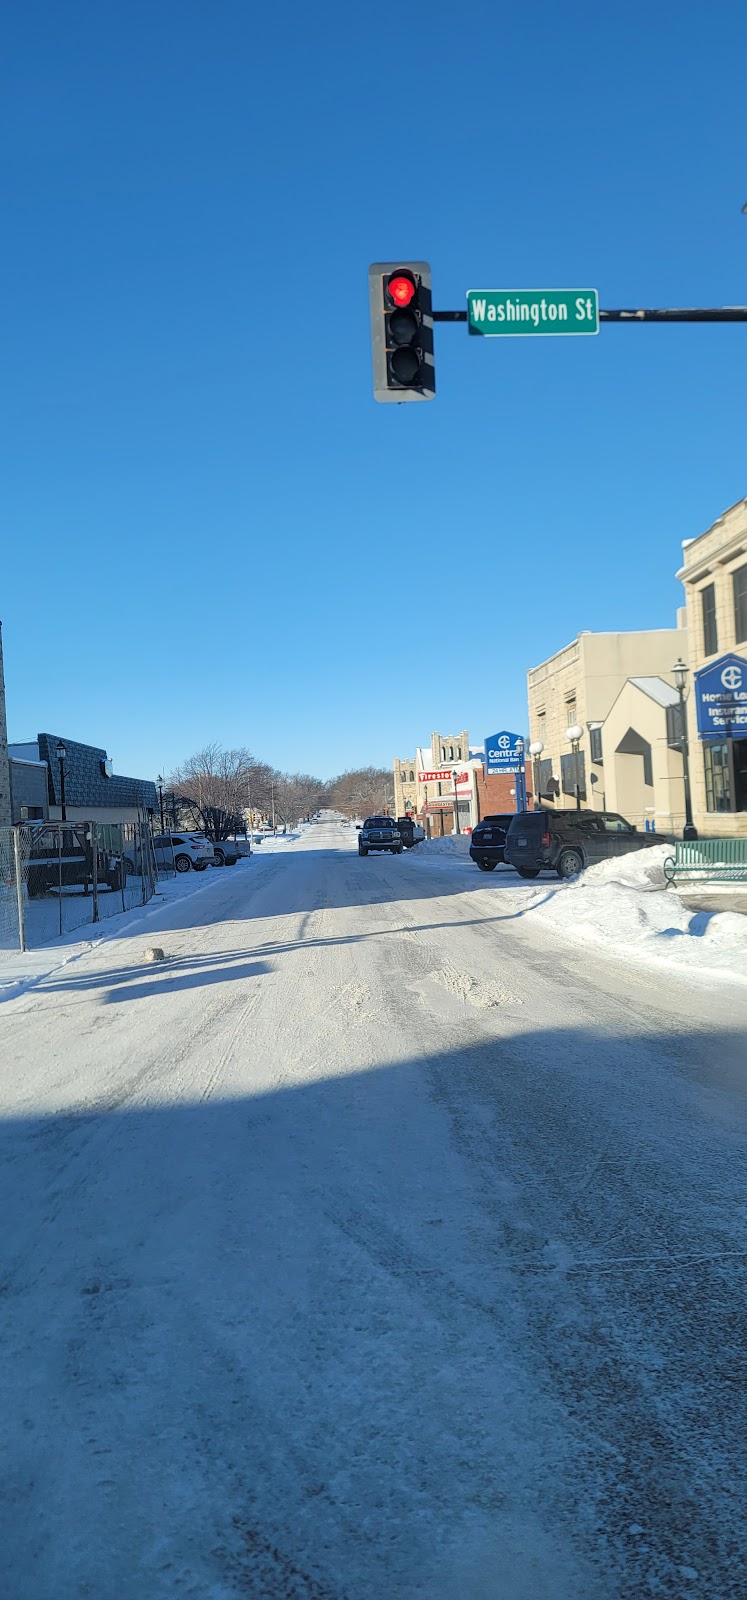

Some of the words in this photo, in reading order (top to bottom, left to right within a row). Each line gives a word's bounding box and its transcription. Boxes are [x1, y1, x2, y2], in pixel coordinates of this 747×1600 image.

[471, 298, 568, 327] Washington
[575, 297, 594, 321] St
[702, 693, 732, 703] Home
[488, 749, 522, 758] Centra
[419, 772, 453, 782] Firesto
